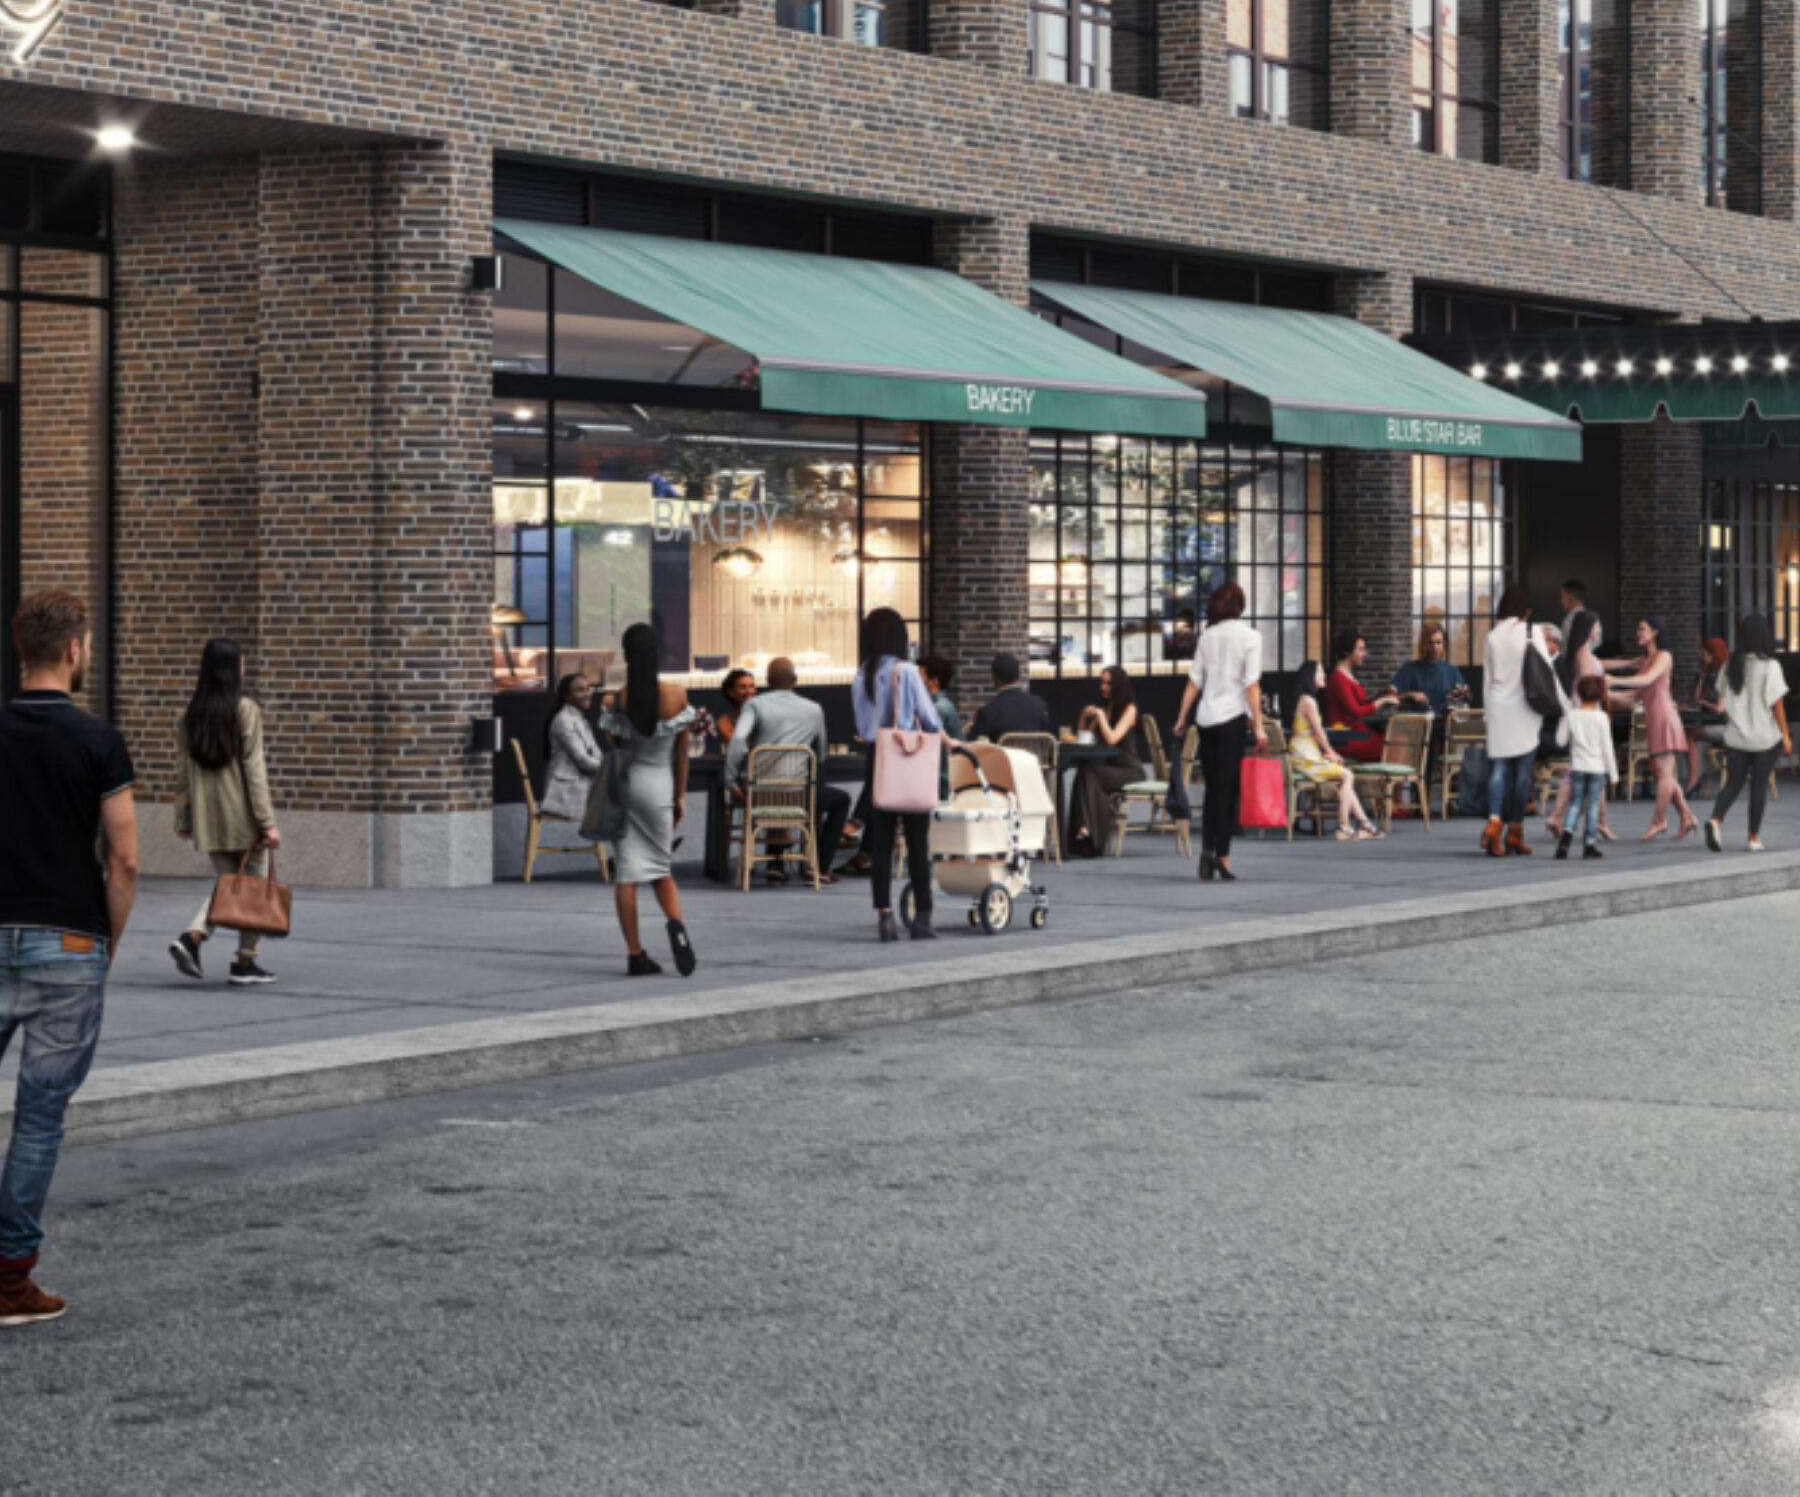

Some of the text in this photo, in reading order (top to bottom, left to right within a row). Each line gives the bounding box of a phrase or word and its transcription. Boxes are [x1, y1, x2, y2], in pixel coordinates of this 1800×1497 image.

[966, 384, 1036, 414] BAKERY
[1386, 417, 1482, 447] BLUE STAR BAR
[653, 500, 779, 543] BAKERY
